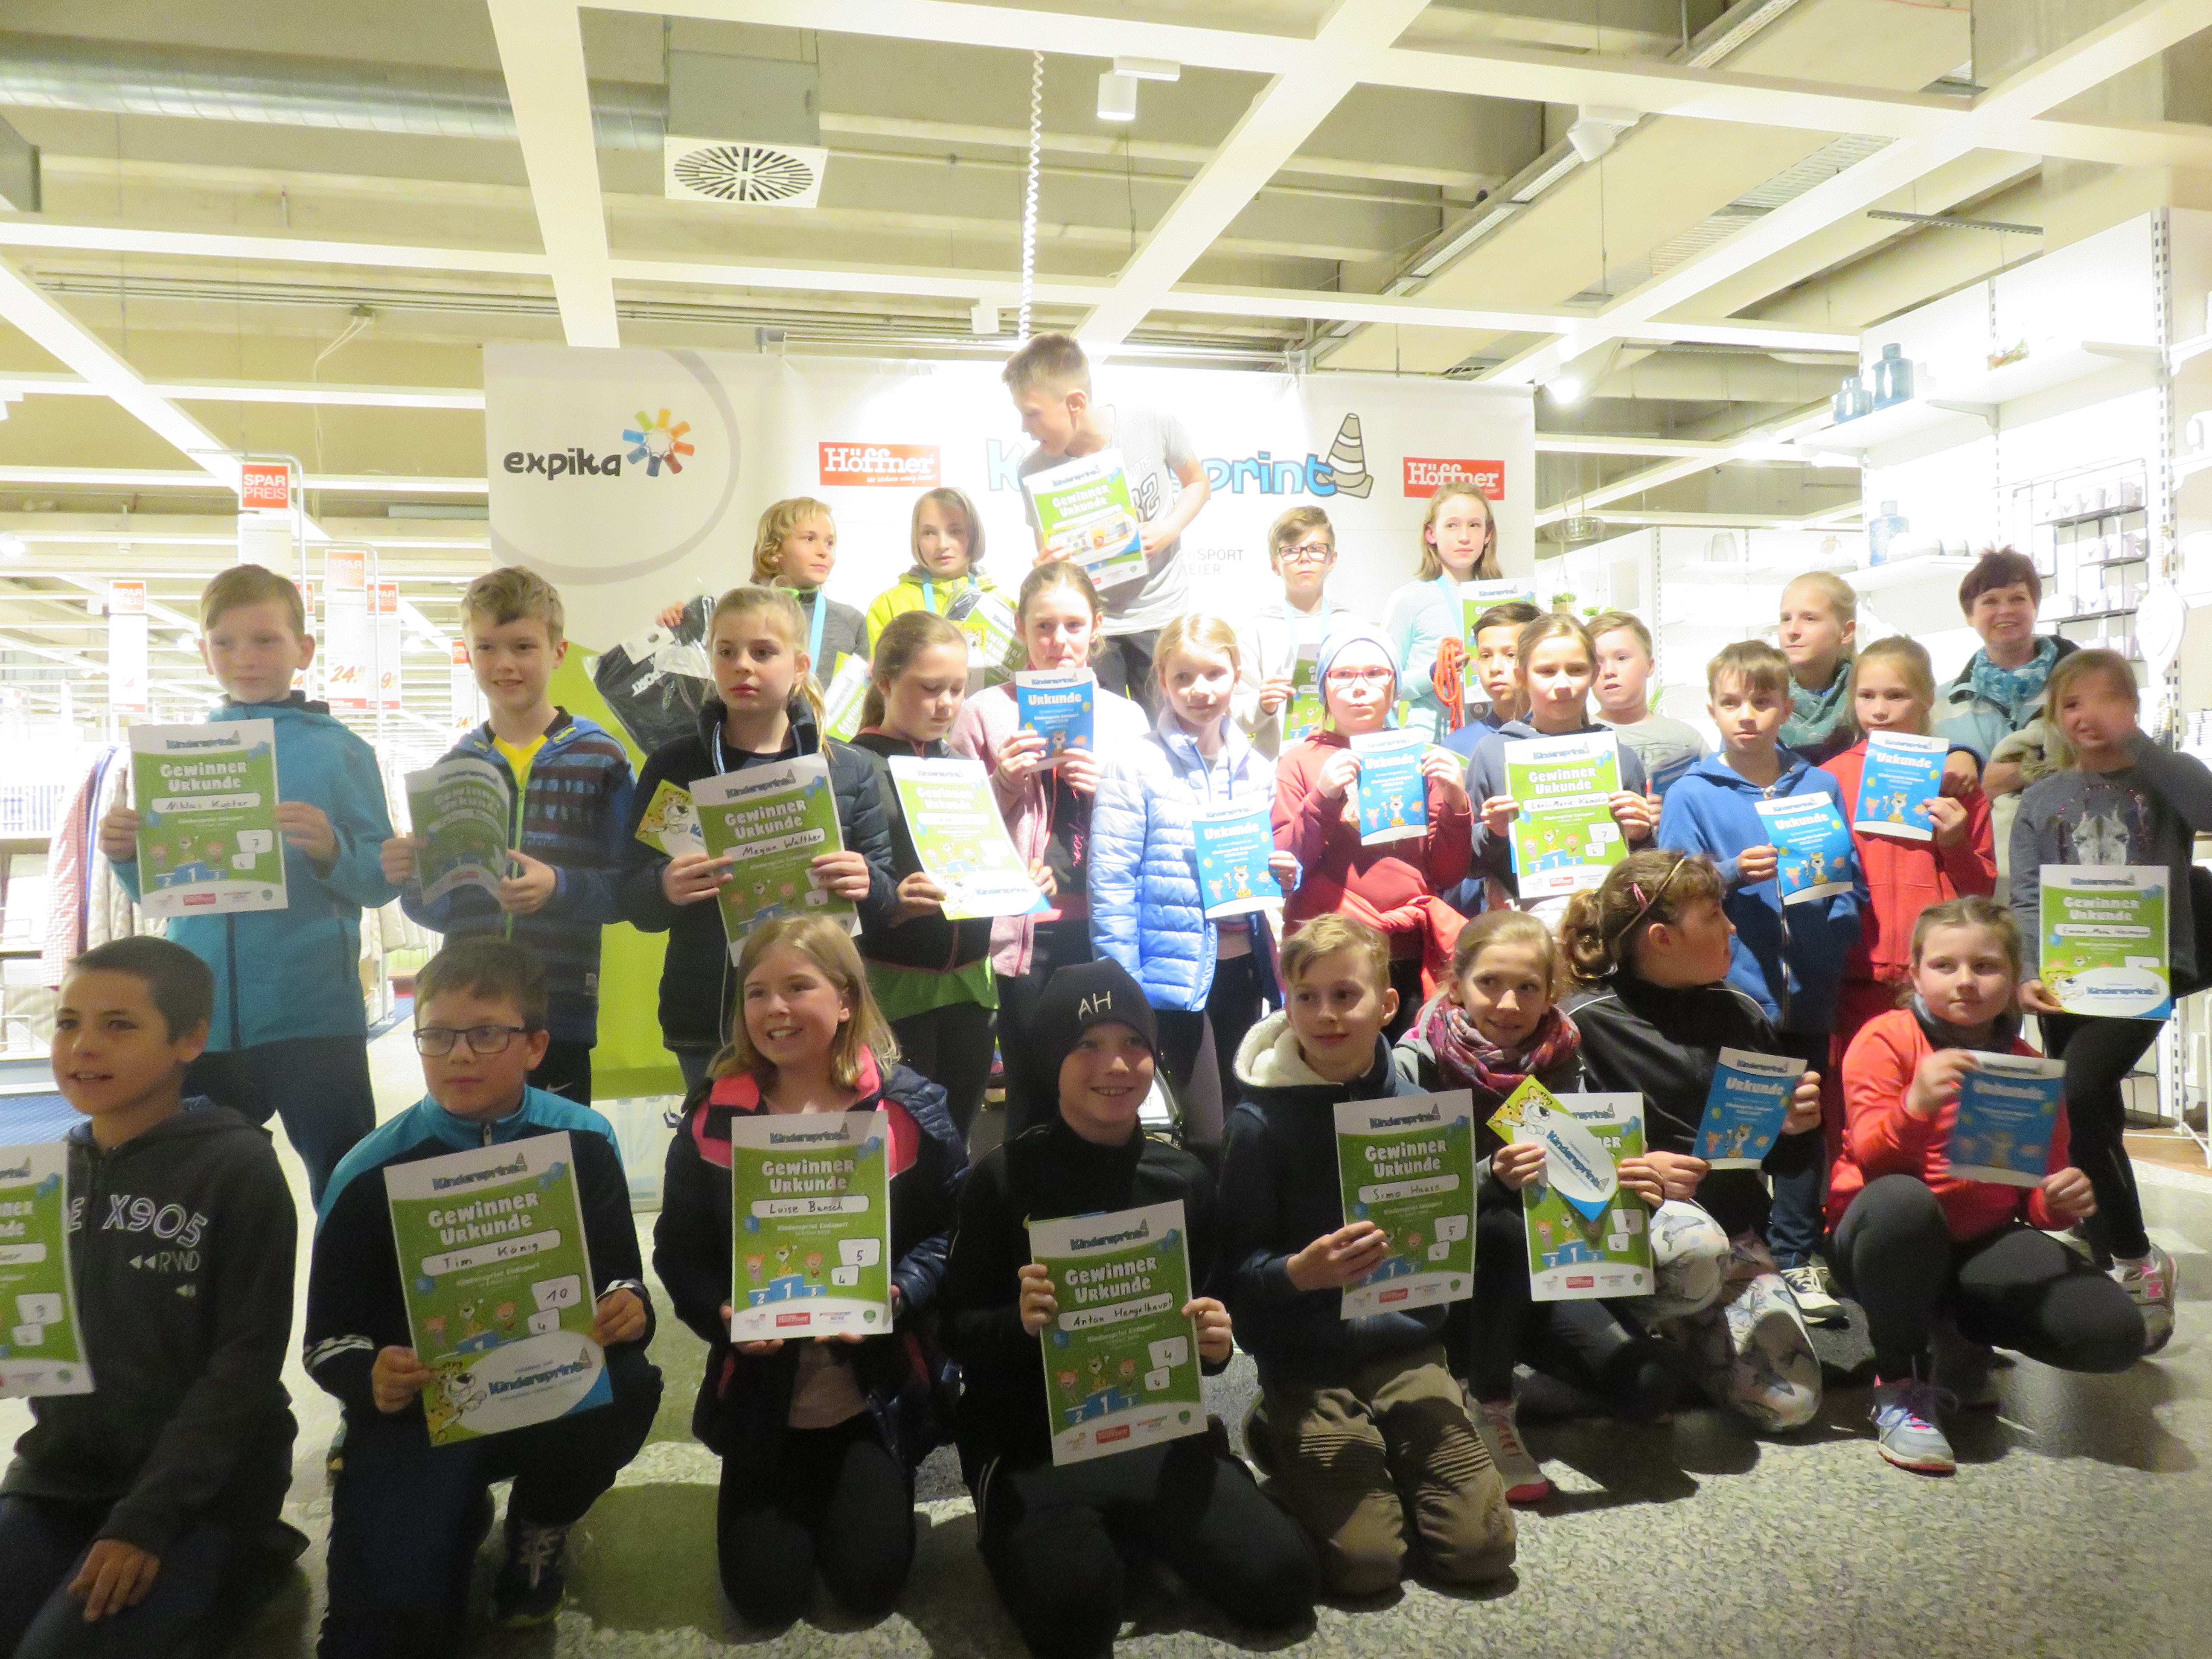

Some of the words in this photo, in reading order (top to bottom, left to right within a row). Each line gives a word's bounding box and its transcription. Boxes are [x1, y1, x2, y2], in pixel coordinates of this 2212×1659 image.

[504, 448, 621, 480] expika
[824, 447, 935, 474] Höffner
[244, 474, 285, 486] SPAR
[1407, 462, 1499, 487] Höffner
[244, 487, 286, 499] PREIS
[329, 559, 362, 569] SPAR
[1078, 990, 1111, 1021] AH
[769, 1203, 799, 1214] Luise
[101, 1194, 208, 1248] X905
[444, 1257, 473, 1270] Tim
[497, 1241, 539, 1257] König
[856, 1250, 864, 1262] 5
[546, 1288, 568, 1302] 10
[784, 1282, 792, 1299] 1
